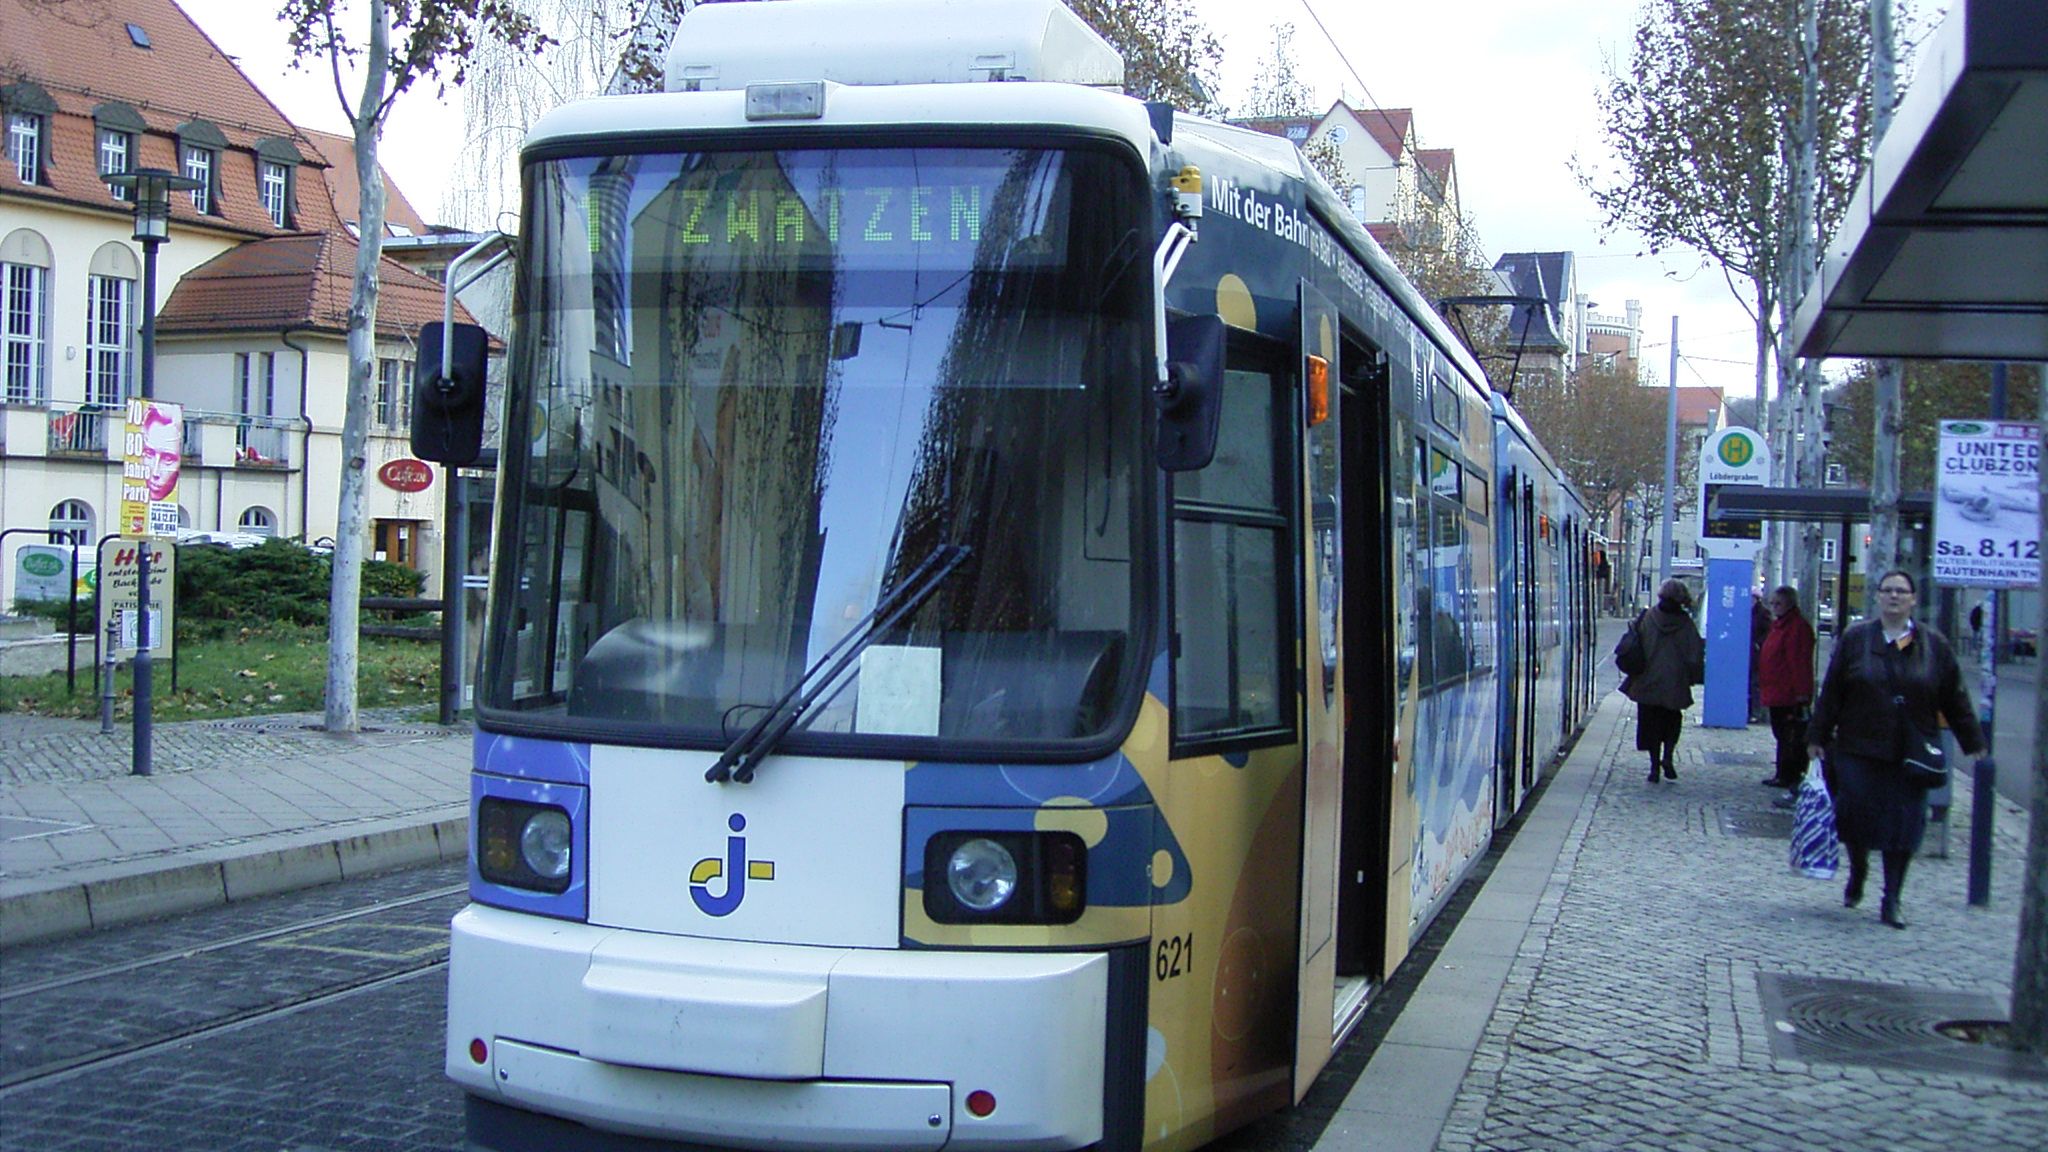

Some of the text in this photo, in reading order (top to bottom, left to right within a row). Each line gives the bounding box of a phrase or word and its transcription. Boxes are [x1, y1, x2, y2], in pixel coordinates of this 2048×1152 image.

[1211, 174, 1241, 219] Mit
[1244, 189, 1271, 231] der
[1957, 442, 2039, 458] UNITED
[123, 484, 150, 503] Party
[1937, 541, 1972, 556] Sa.
[1156, 932, 1193, 981] 621
